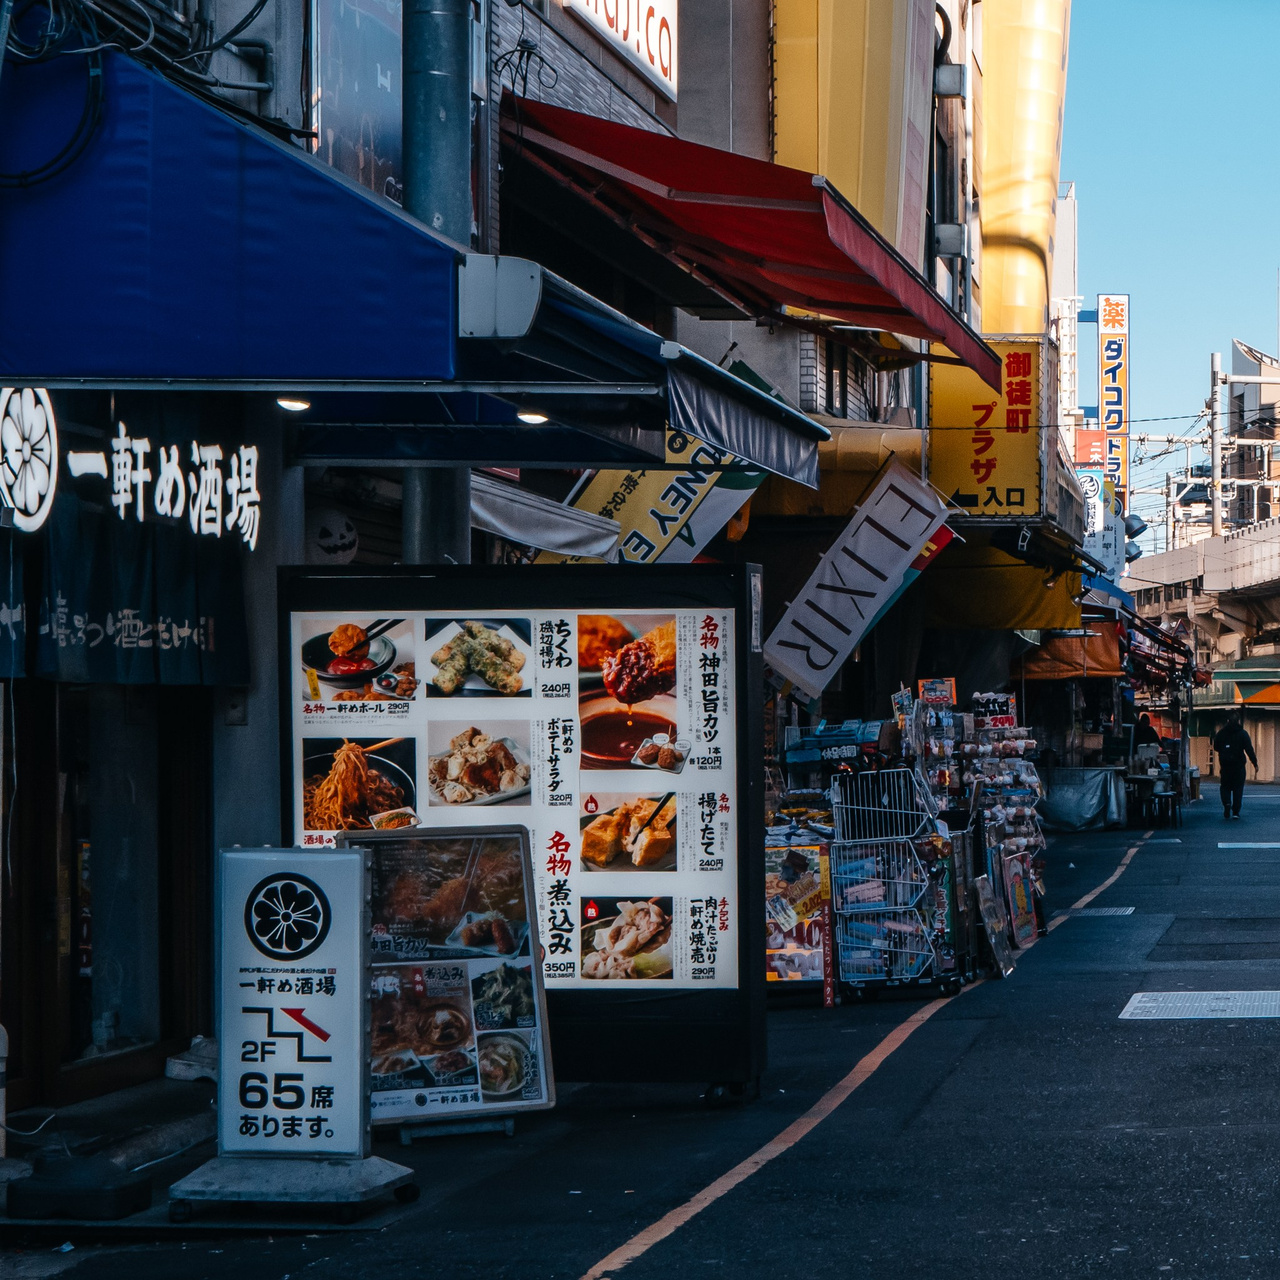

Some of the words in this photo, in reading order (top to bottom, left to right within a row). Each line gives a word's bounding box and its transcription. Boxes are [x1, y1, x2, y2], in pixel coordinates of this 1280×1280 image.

[1103, 297, 1125, 328] 薬
[1005, 351, 1032, 435] 御徒町
[1104, 338, 1124, 431] ダイコク
[970, 401, 997, 484] プラザ
[67, 421, 261, 552] 一軒め酒場
[983, 487, 1025, 507] 入口
[777, 483, 937, 670] ELIXIR
[539, 620, 556, 669] 磯辺揚げ
[554, 619, 573, 668] ちくわ
[541, 683, 571, 693] 240円
[387, 702, 410, 710] 290円
[561, 718, 575, 754] 一軒めの
[547, 717, 564, 792] ポテトサラダ
[549, 793, 573, 802] 320円
[718, 792, 730, 814] 名物
[698, 792, 718, 857] 揚げたて
[699, 858, 724, 868] 240円
[704, 896, 719, 965] 肉汁たっぷり
[718, 896, 730, 932] 手包み
[689, 899, 707, 965] 一軒め焼売
[544, 962, 576, 973] 350円
[691, 967, 716, 976] 290円
[239, 976, 337, 997] 一軒め酒場
[241, 1040, 277, 1063] 2F
[429, 1093, 480, 1105] 一軒め酒場
[239, 1114, 335, 1139] あります。
